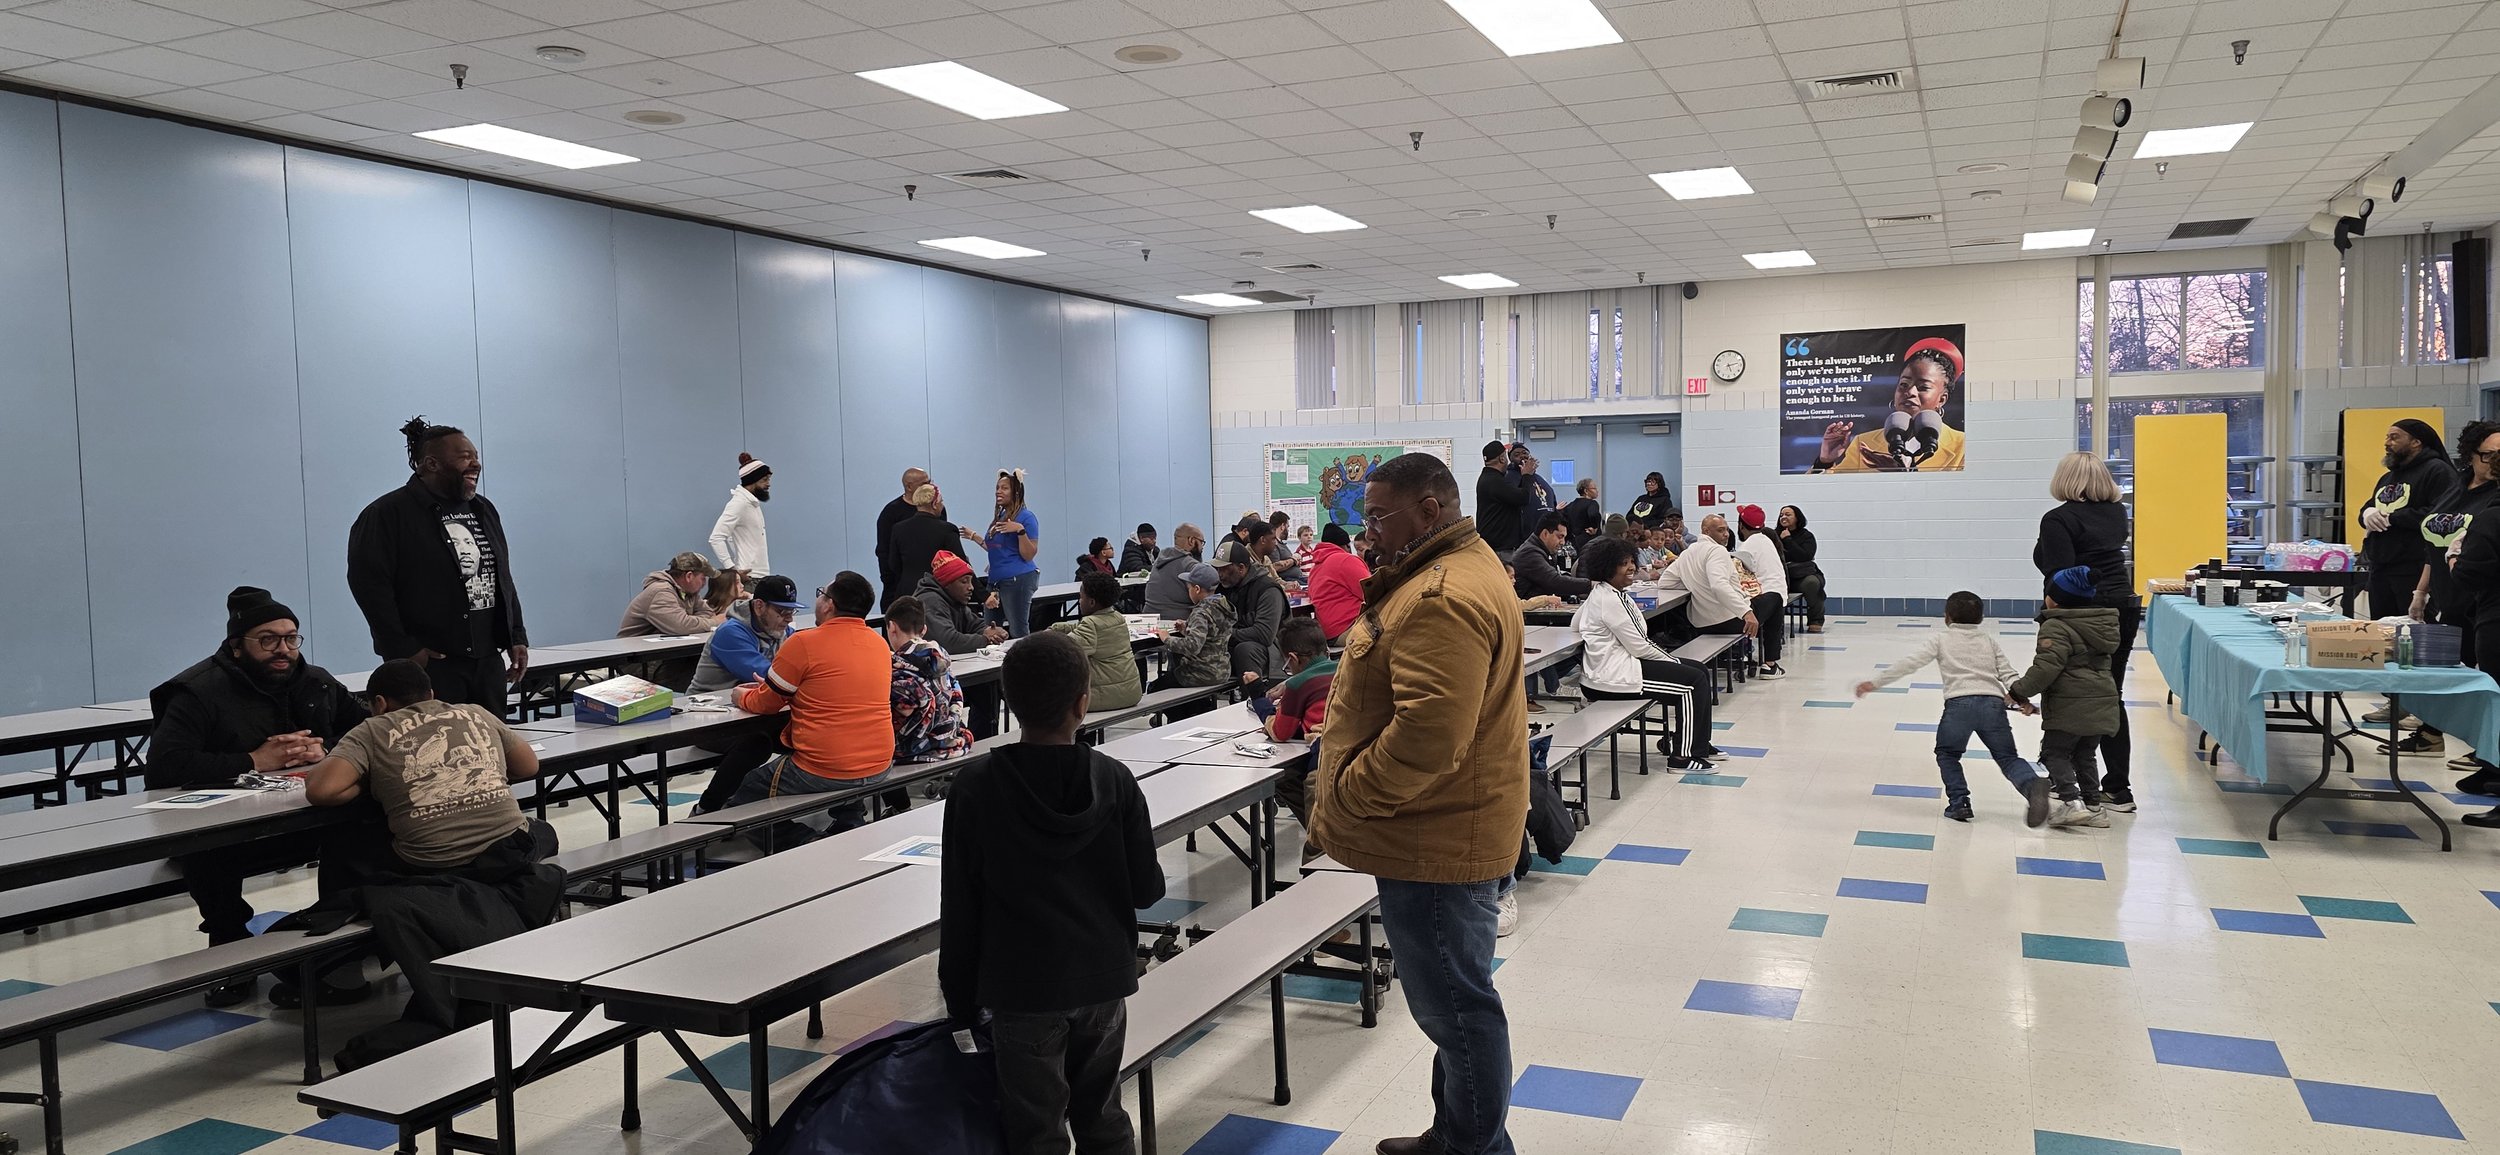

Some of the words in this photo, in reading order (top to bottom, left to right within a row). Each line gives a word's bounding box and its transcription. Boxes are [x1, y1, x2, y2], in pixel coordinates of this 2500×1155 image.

[1786, 358, 1813, 366] There
[1814, 357, 1823, 365] is
[1825, 356, 1857, 365] always
[1858, 355, 1884, 365] light,
[1886, 354, 1895, 362] if
[1786, 368, 1806, 377] only
[1835, 366, 1862, 374] brave
[1687, 378, 1707, 393] EXIT
[1786, 376, 1820, 386] enough
[1850, 375, 1861, 383] it.
[1862, 374, 1872, 382] If
[1786, 386, 1806, 396] only
[1835, 385, 1862, 393] brave
[1786, 395, 1820, 405] enough
[1832, 394, 1845, 402] be
[1846, 394, 1857, 402] it.
[388, 709, 491, 748] ARIZONA
[410, 801, 458, 818] GRAND
[463, 789, 510, 804] CANYON
